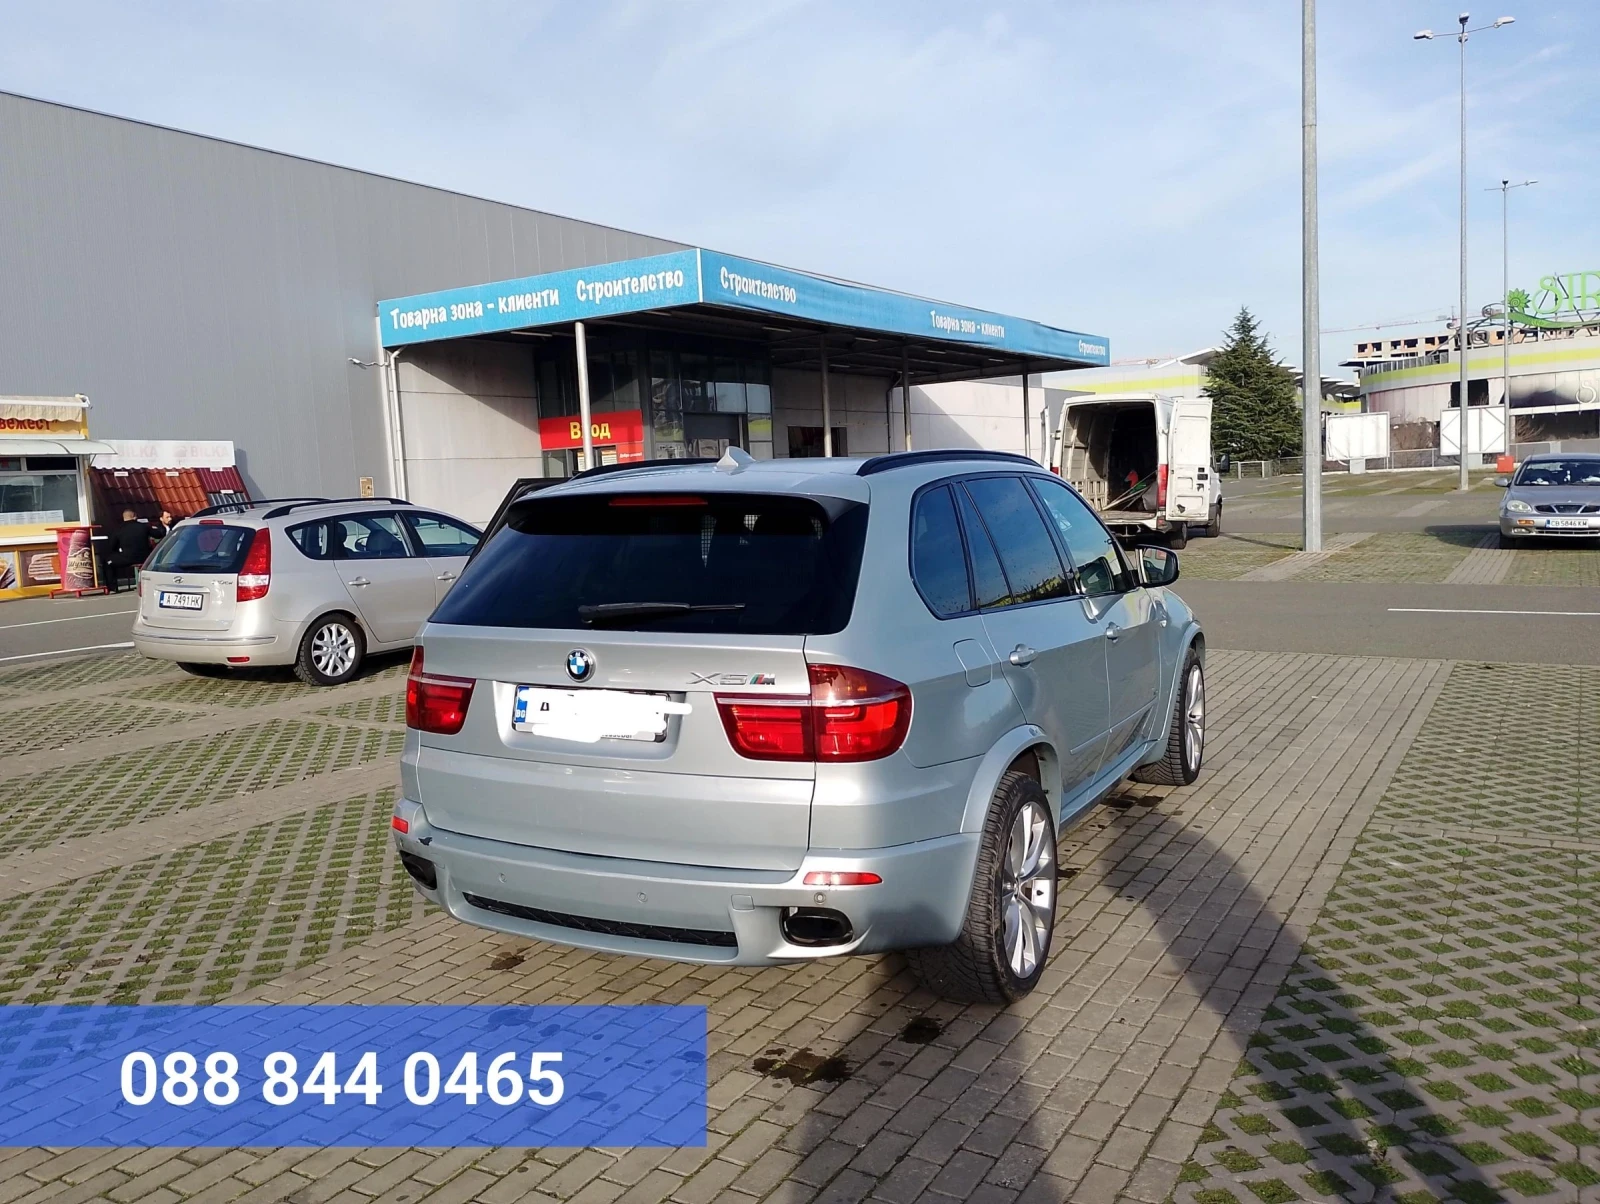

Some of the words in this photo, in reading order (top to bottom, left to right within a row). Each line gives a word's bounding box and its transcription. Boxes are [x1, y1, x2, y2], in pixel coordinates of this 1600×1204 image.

[577, 269, 684, 303] Строителство
[720, 266, 796, 303] Строителство
[390, 304, 447, 330] Товарна
[450, 299, 483, 321] зона
[498, 287, 560, 315] клиенти
[930, 309, 959, 334] Товарна
[960, 319, 976, 334] зона
[981, 321, 1005, 339] клиенти
[570, 421, 611, 440] Вод
[174, 595, 190, 605] 7491
